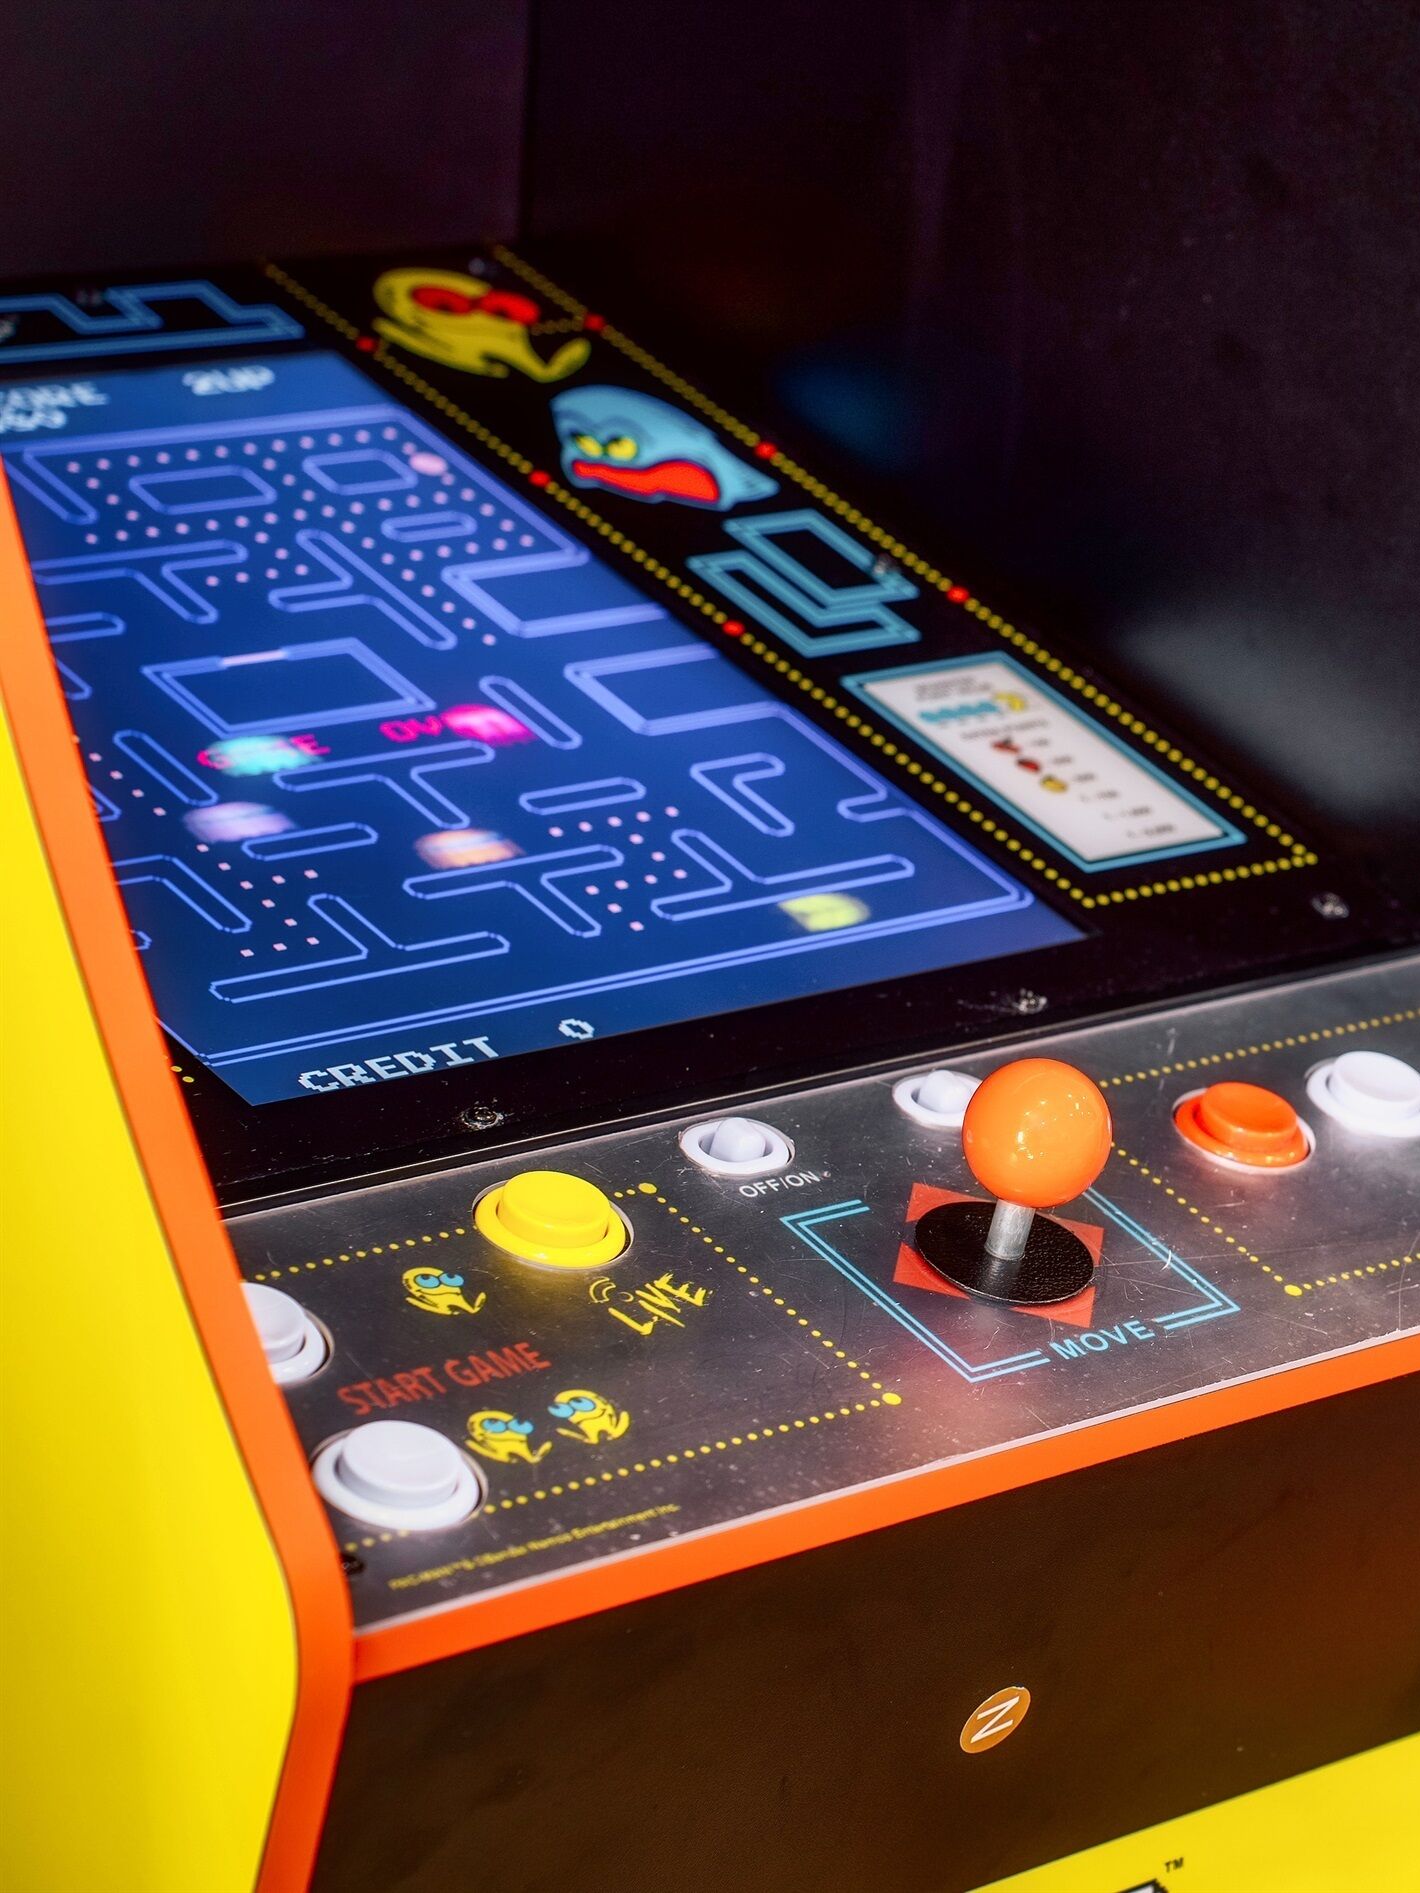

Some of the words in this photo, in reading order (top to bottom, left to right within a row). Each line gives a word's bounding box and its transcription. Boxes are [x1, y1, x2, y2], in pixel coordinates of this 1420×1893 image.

[298, 1035, 501, 1093] CREDIT
[739, 1170, 821, 1198] OFF/ON
[608, 1272, 706, 1336] LIVE
[1050, 1320, 1156, 1360] MOVE
[337, 1366, 447, 1416] START
[444, 1342, 552, 1387] GAME
